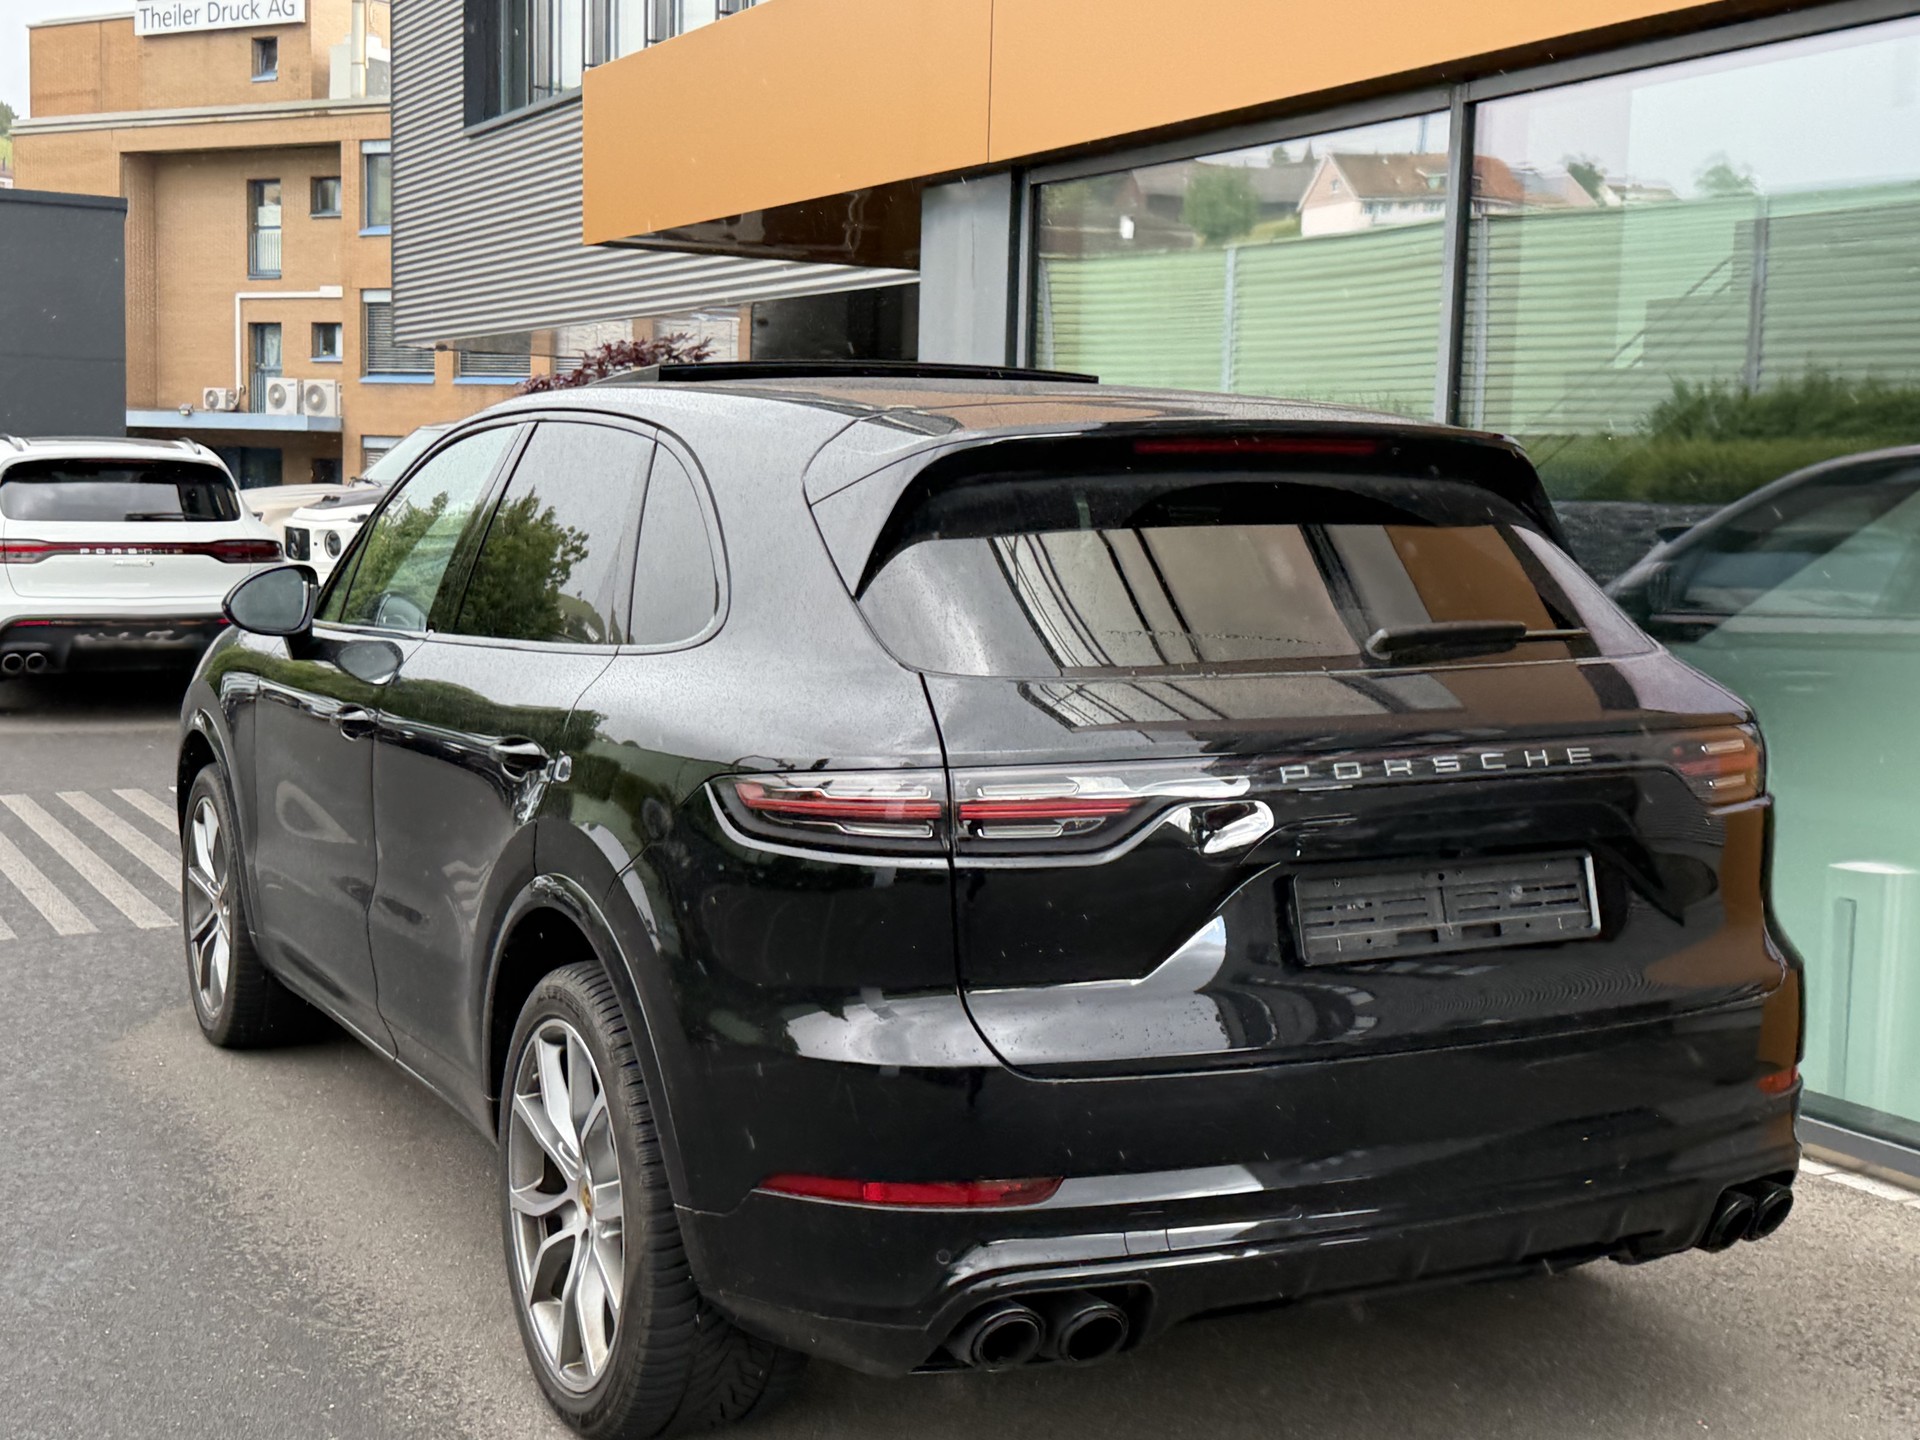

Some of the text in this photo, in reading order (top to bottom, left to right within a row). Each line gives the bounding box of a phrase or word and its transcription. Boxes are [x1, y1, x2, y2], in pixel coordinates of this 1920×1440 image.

[139, 0, 295, 29] Theiler Druck AG
[1280, 747, 1592, 784] PORSCHE
